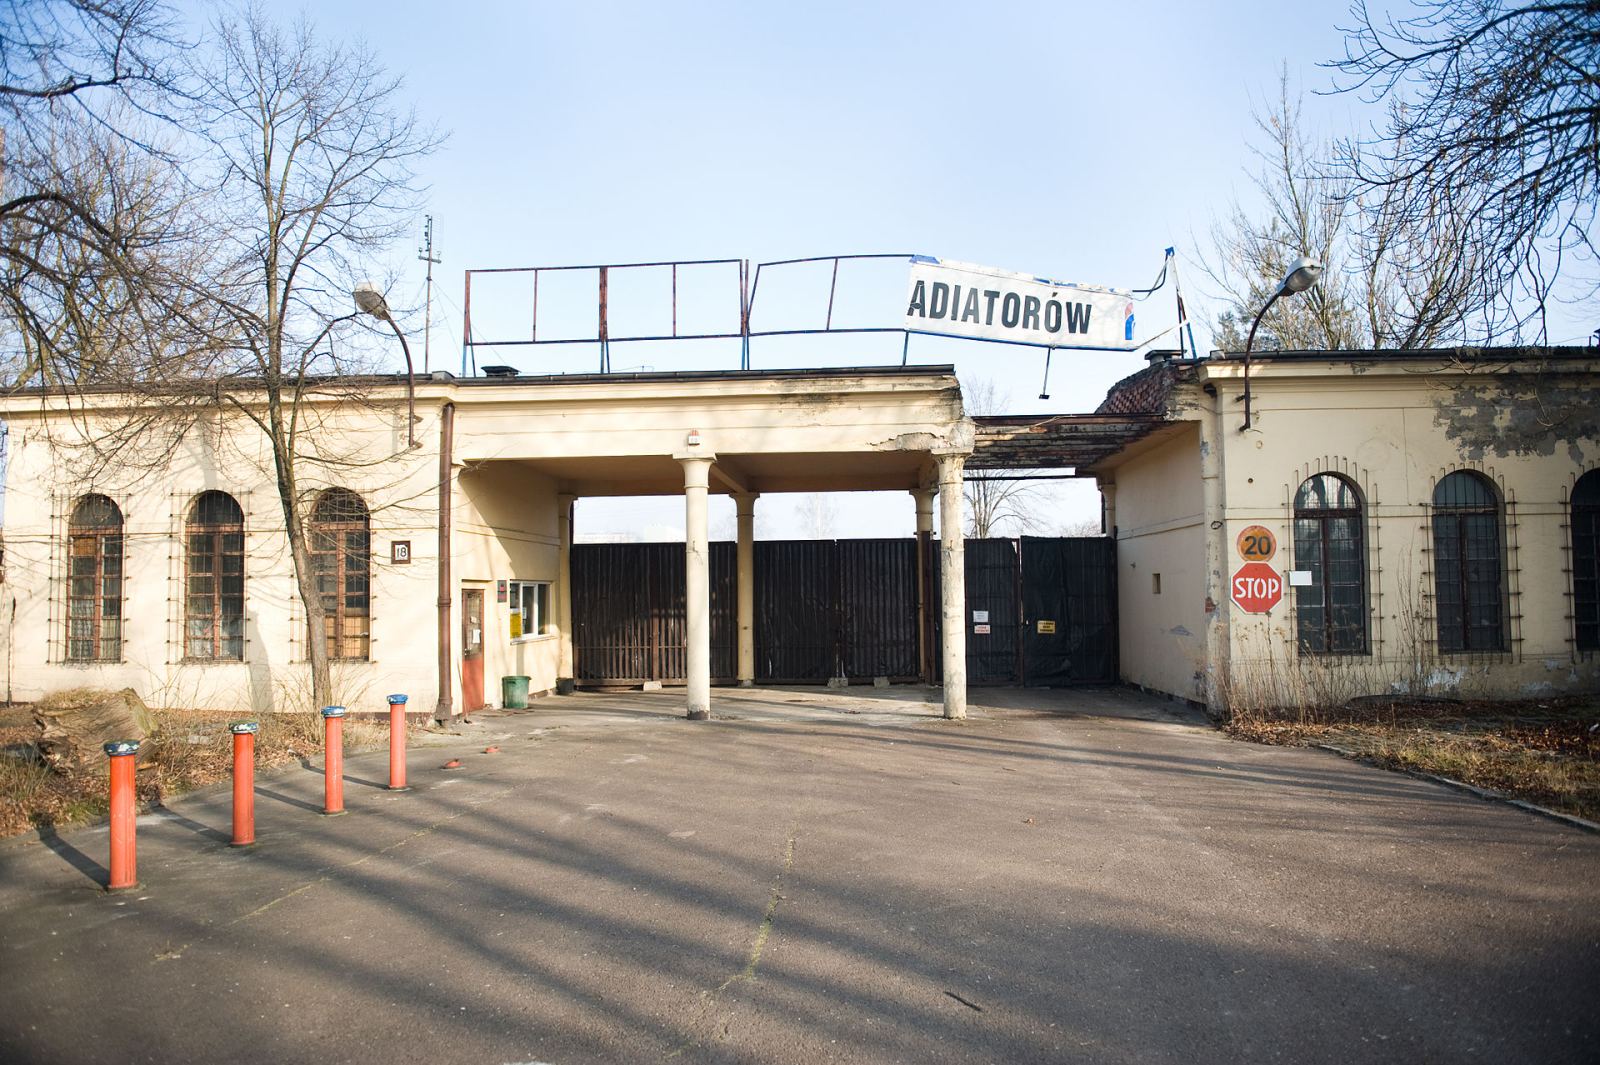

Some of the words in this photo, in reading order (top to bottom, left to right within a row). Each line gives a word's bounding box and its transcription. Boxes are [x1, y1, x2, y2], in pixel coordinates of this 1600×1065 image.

[907, 280, 1092, 334] ADIATORÓW
[397, 547, 407, 558] 18
[1244, 536, 1272, 555] 20
[1234, 577, 1279, 599] STOP
